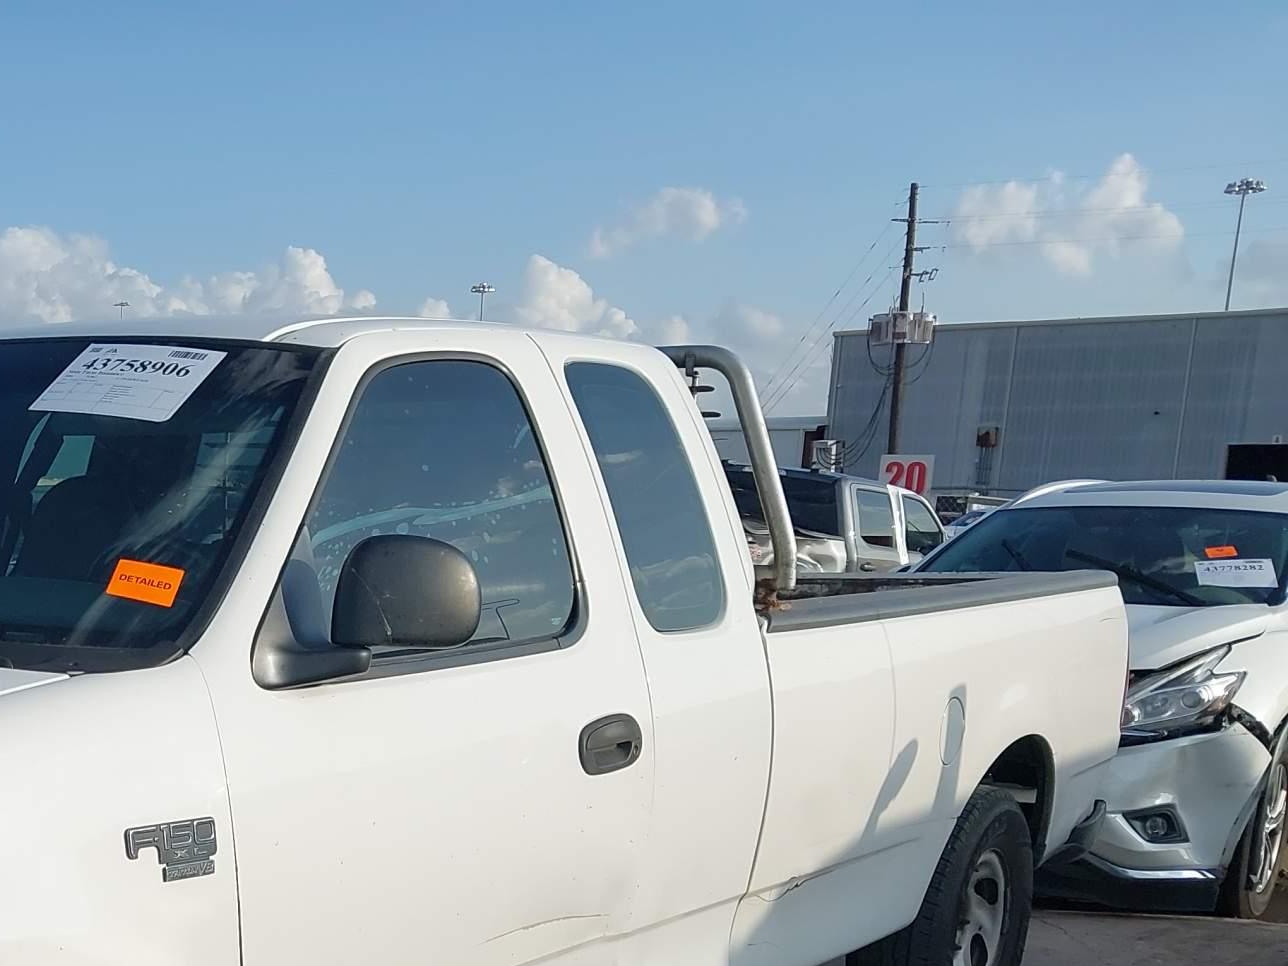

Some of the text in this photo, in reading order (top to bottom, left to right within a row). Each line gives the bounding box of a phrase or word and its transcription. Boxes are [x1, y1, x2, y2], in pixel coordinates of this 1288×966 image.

[82, 357, 194, 378] 43758906
[885, 461, 926, 495] 20
[119, 574, 172, 590] DETAILED
